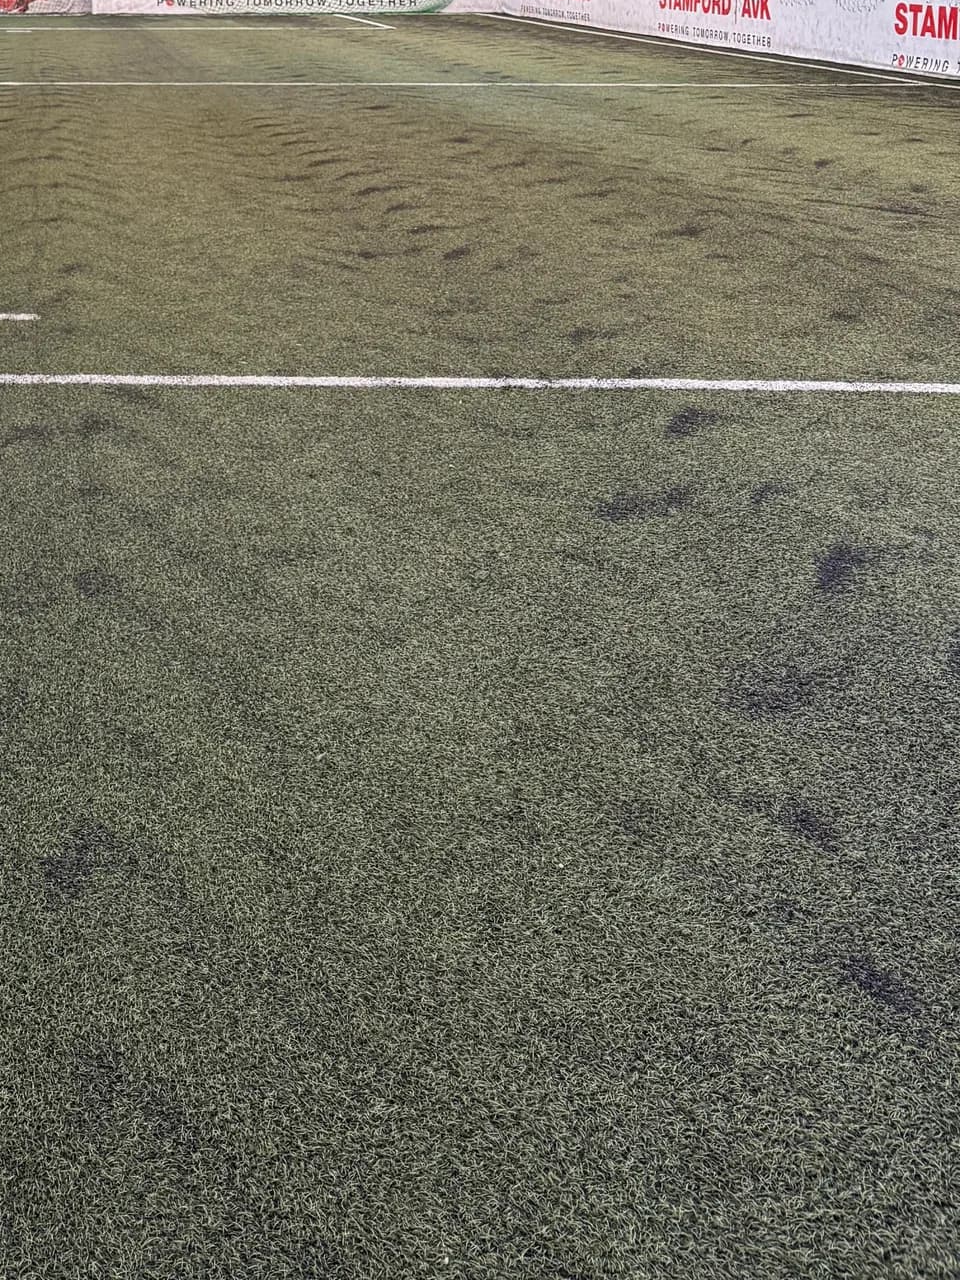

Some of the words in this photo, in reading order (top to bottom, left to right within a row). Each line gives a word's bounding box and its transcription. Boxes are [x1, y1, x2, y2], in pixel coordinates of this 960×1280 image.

[657, 22, 690, 36] POWERING
[733, 32, 772, 48] TOGETHER
[891, 53, 950, 73] POWERING
